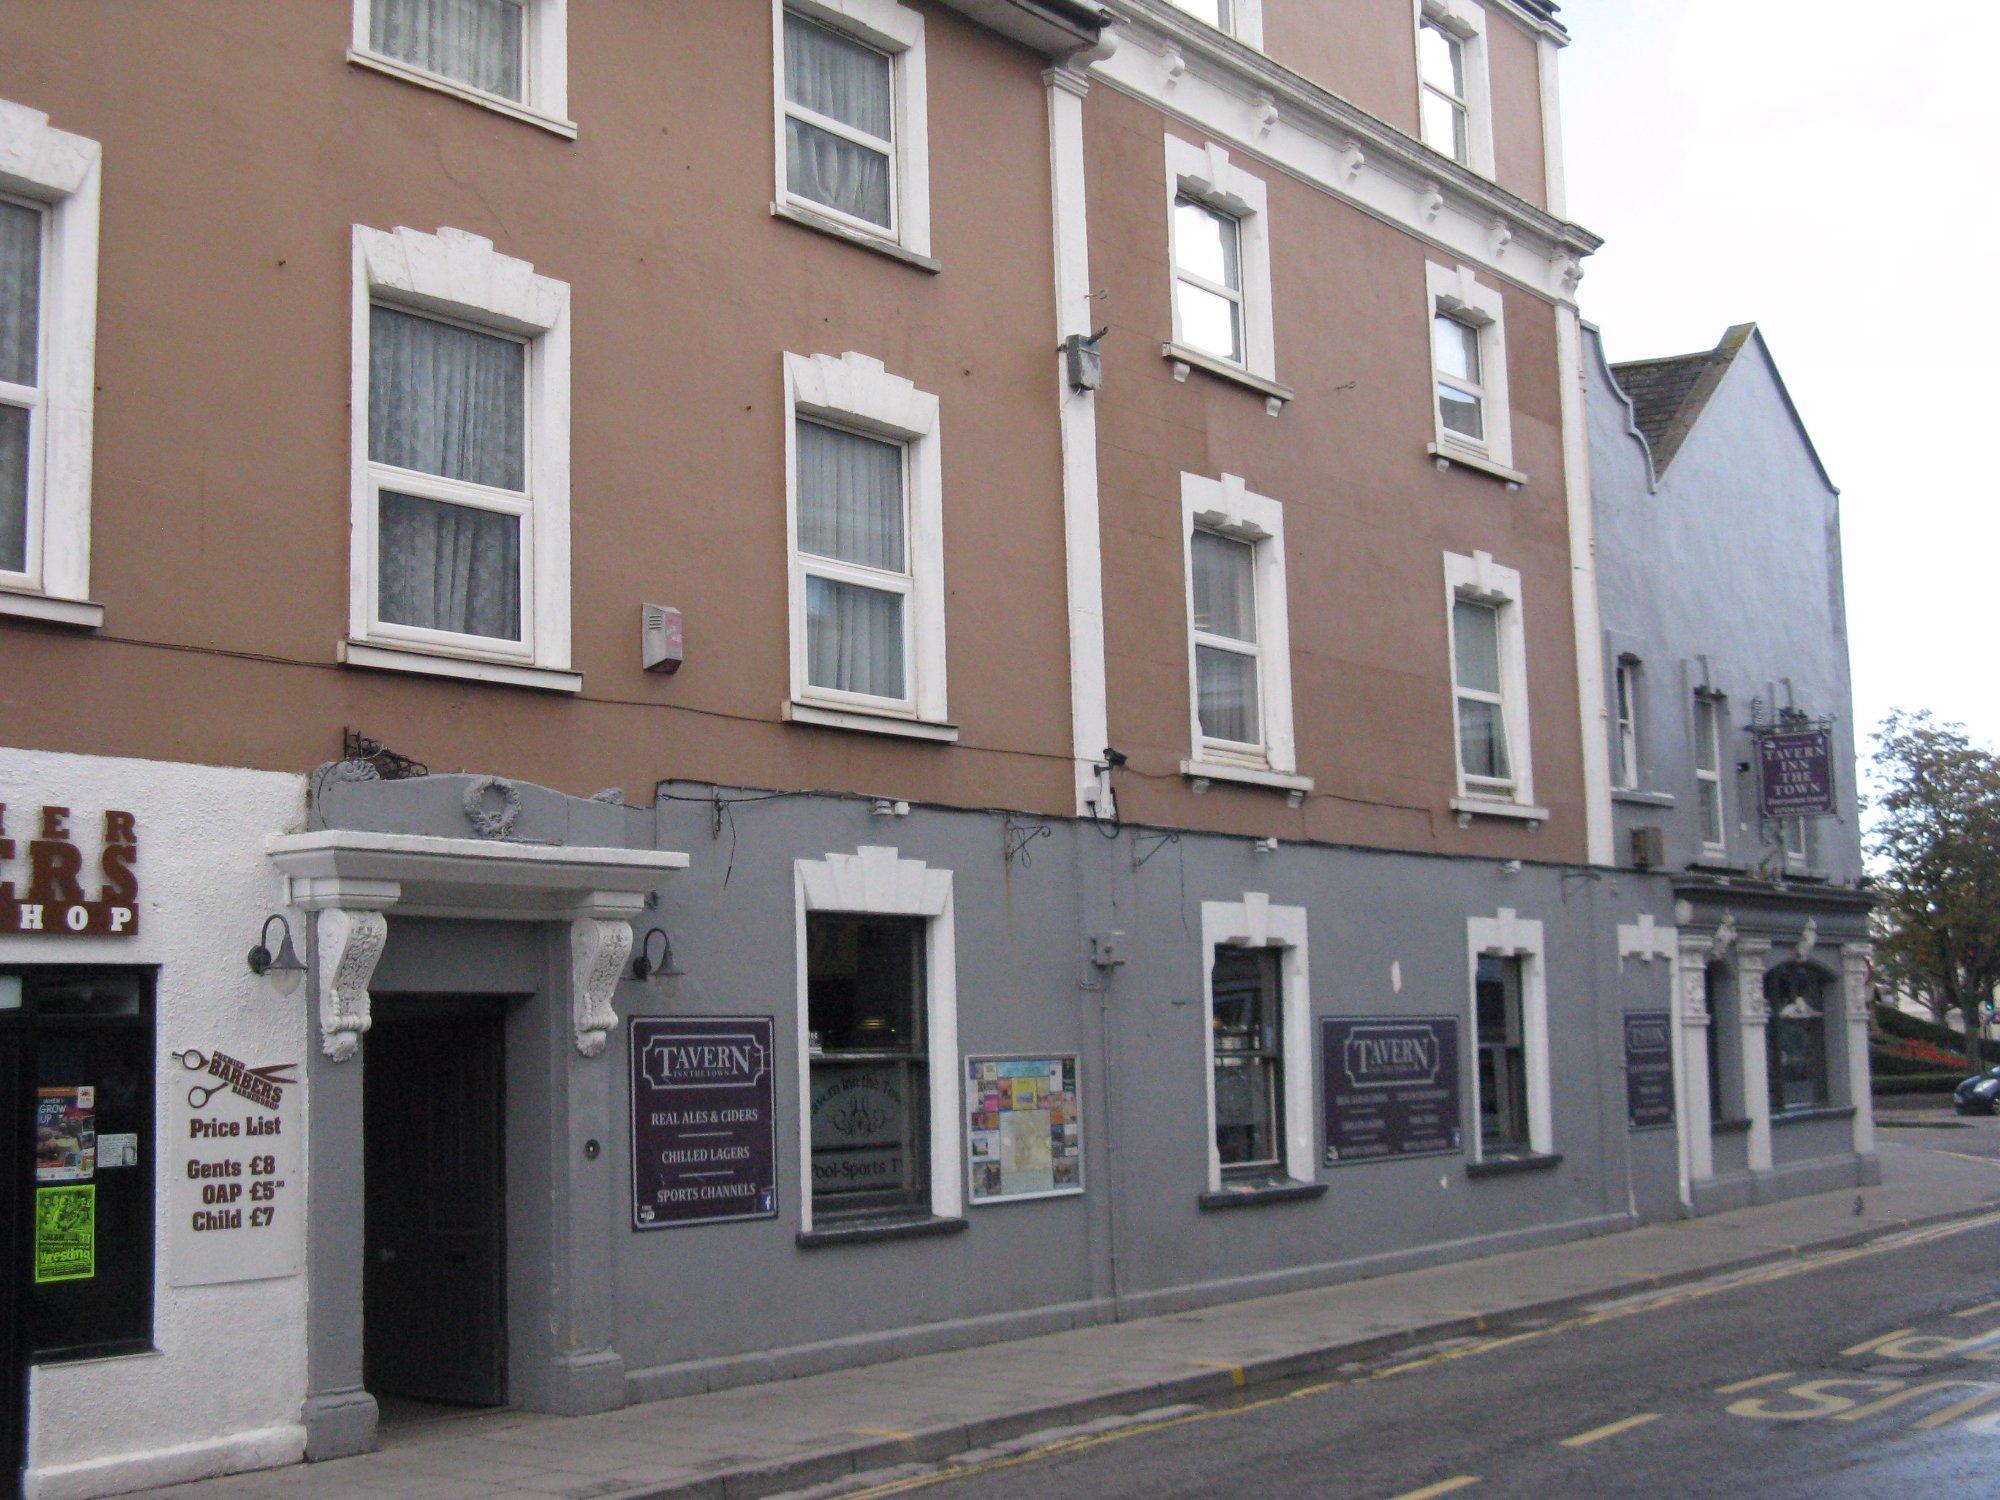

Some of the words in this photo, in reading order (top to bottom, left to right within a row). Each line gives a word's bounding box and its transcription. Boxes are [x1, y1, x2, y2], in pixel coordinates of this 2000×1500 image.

[654, 1046, 751, 1077] TAVERN
[1353, 1038, 1429, 1073] TAVERN
[208, 1059, 283, 1103] BARBERS
[40, 1104, 66, 1114] GROW
[40, 1113, 52, 1124] UP
[651, 1112, 680, 1126] REAL
[682, 1110, 708, 1124] ALES
[710, 1111, 718, 1123] &
[721, 1108, 758, 1123] CIDERS
[190, 1117, 240, 1138] Price
[246, 1115, 281, 1136] List
[661, 1149, 708, 1164] CHILLED
[710, 1146, 750, 1160] LAGERS
[187, 1158, 241, 1179] Gents
[249, 1155, 275, 1175] £8
[202, 1183, 242, 1204] OAP
[657, 1187, 699, 1203] SPORTS
[701, 1183, 756, 1199] CHANNELS
[192, 1209, 242, 1231] Child
[249, 1206, 275, 1226] £7
